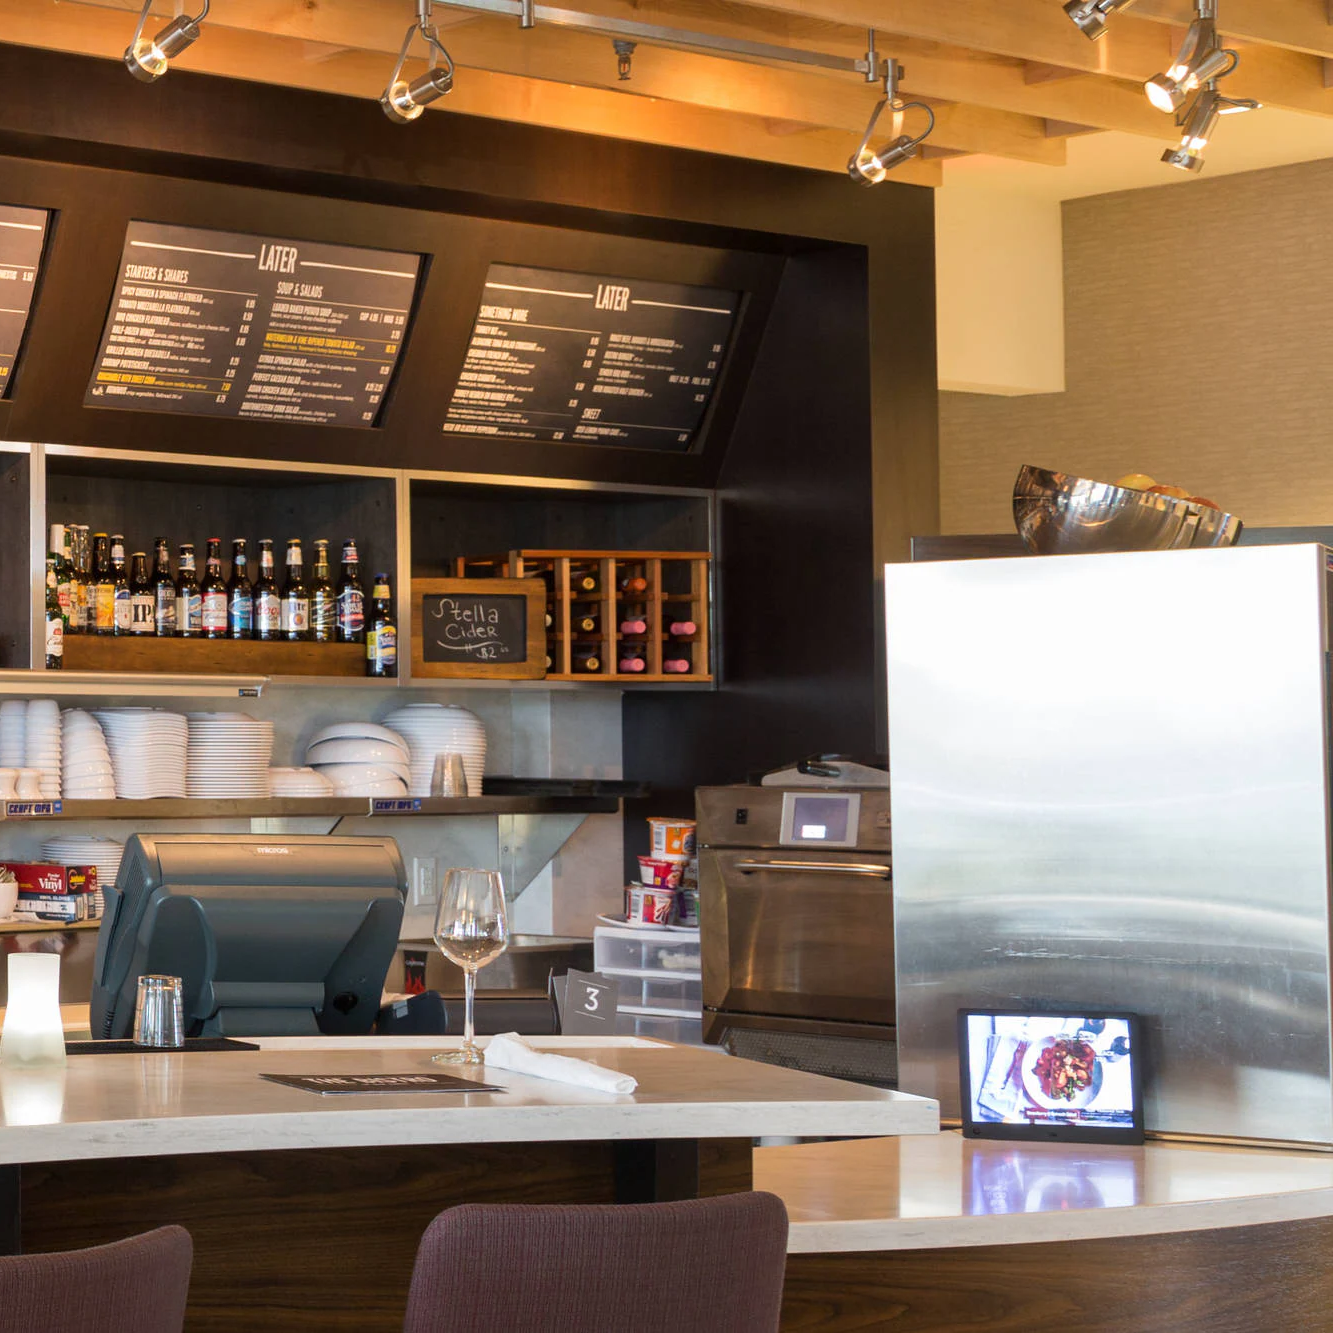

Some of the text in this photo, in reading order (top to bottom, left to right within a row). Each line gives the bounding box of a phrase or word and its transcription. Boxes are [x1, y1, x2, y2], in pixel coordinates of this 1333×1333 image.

[258, 244, 298, 273] LATER
[125, 264, 157, 281] STARTERS
[163, 269, 189, 284] SHARES
[277, 282, 294, 294] SOUP
[300, 284, 323, 298] SALADS
[595, 284, 630, 312] LATER
[432, 599, 498, 623] Stella
[38, 877, 62, 892] Vinyl
[584, 987, 599, 1011] 3
